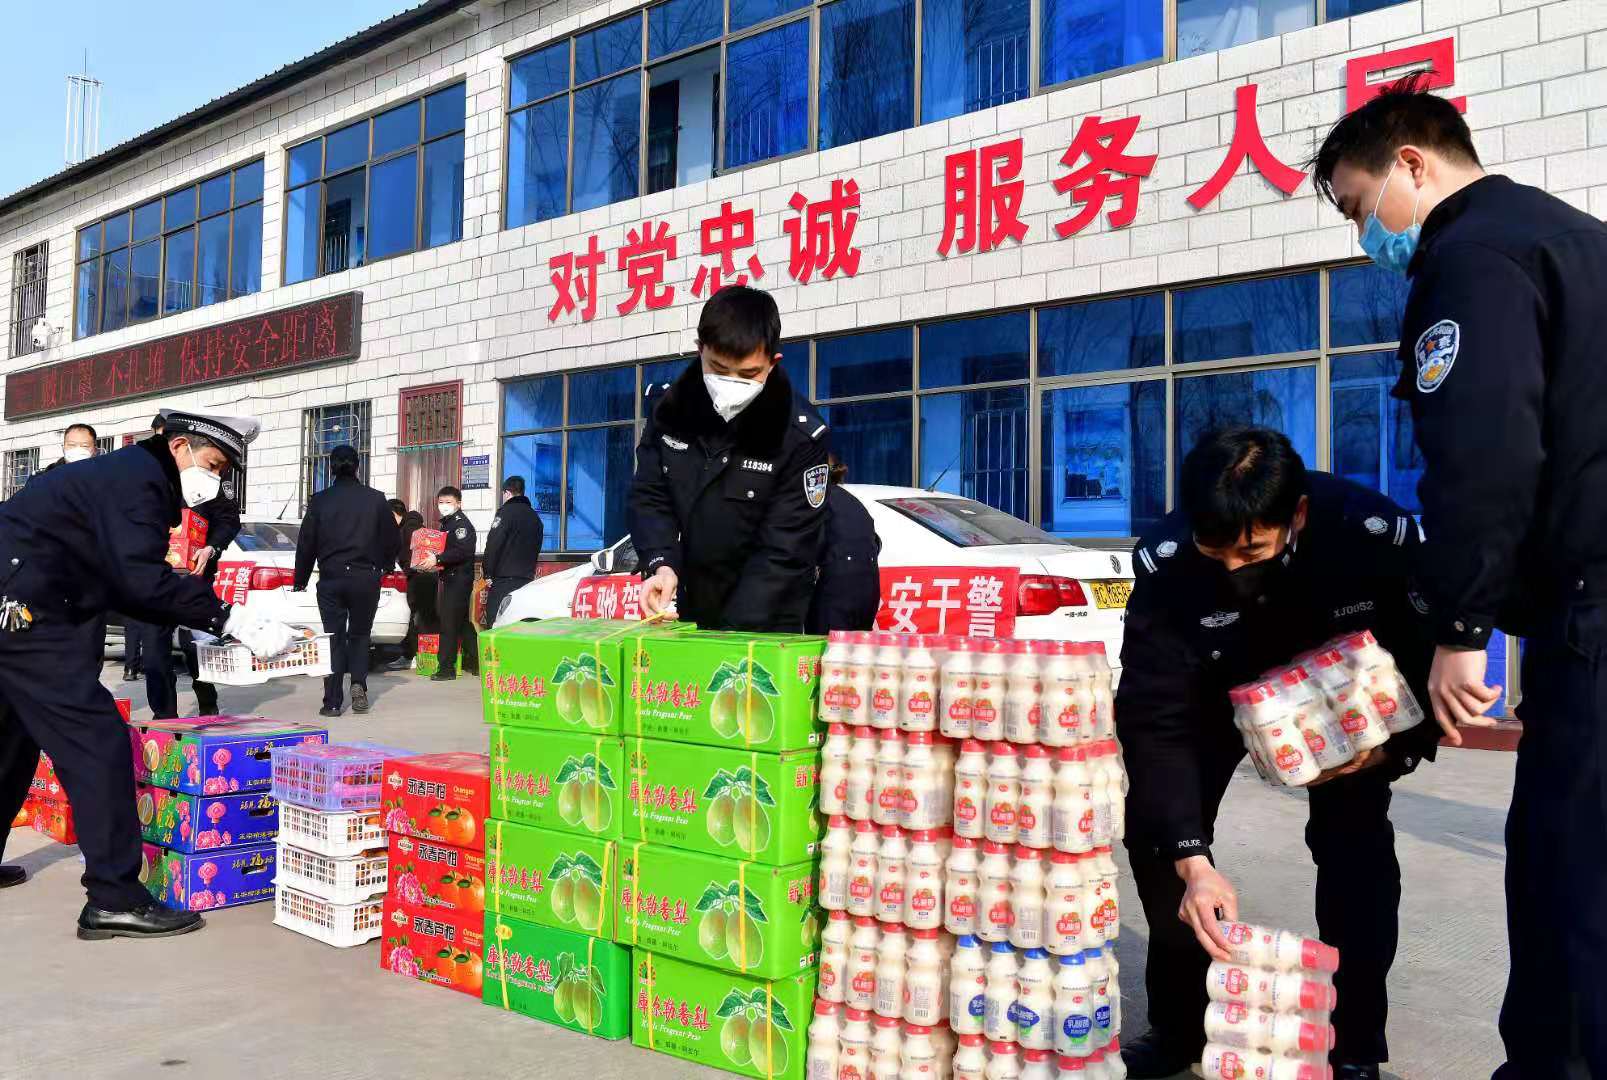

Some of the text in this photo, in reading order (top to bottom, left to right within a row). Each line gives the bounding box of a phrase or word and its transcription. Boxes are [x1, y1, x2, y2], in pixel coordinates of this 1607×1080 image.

[547, 177, 863, 323] 对党忠诚
[214, 566, 252, 603] 干警
[876, 575, 1004, 639] 安干警
[1178, 839, 1202, 849] POLICE
